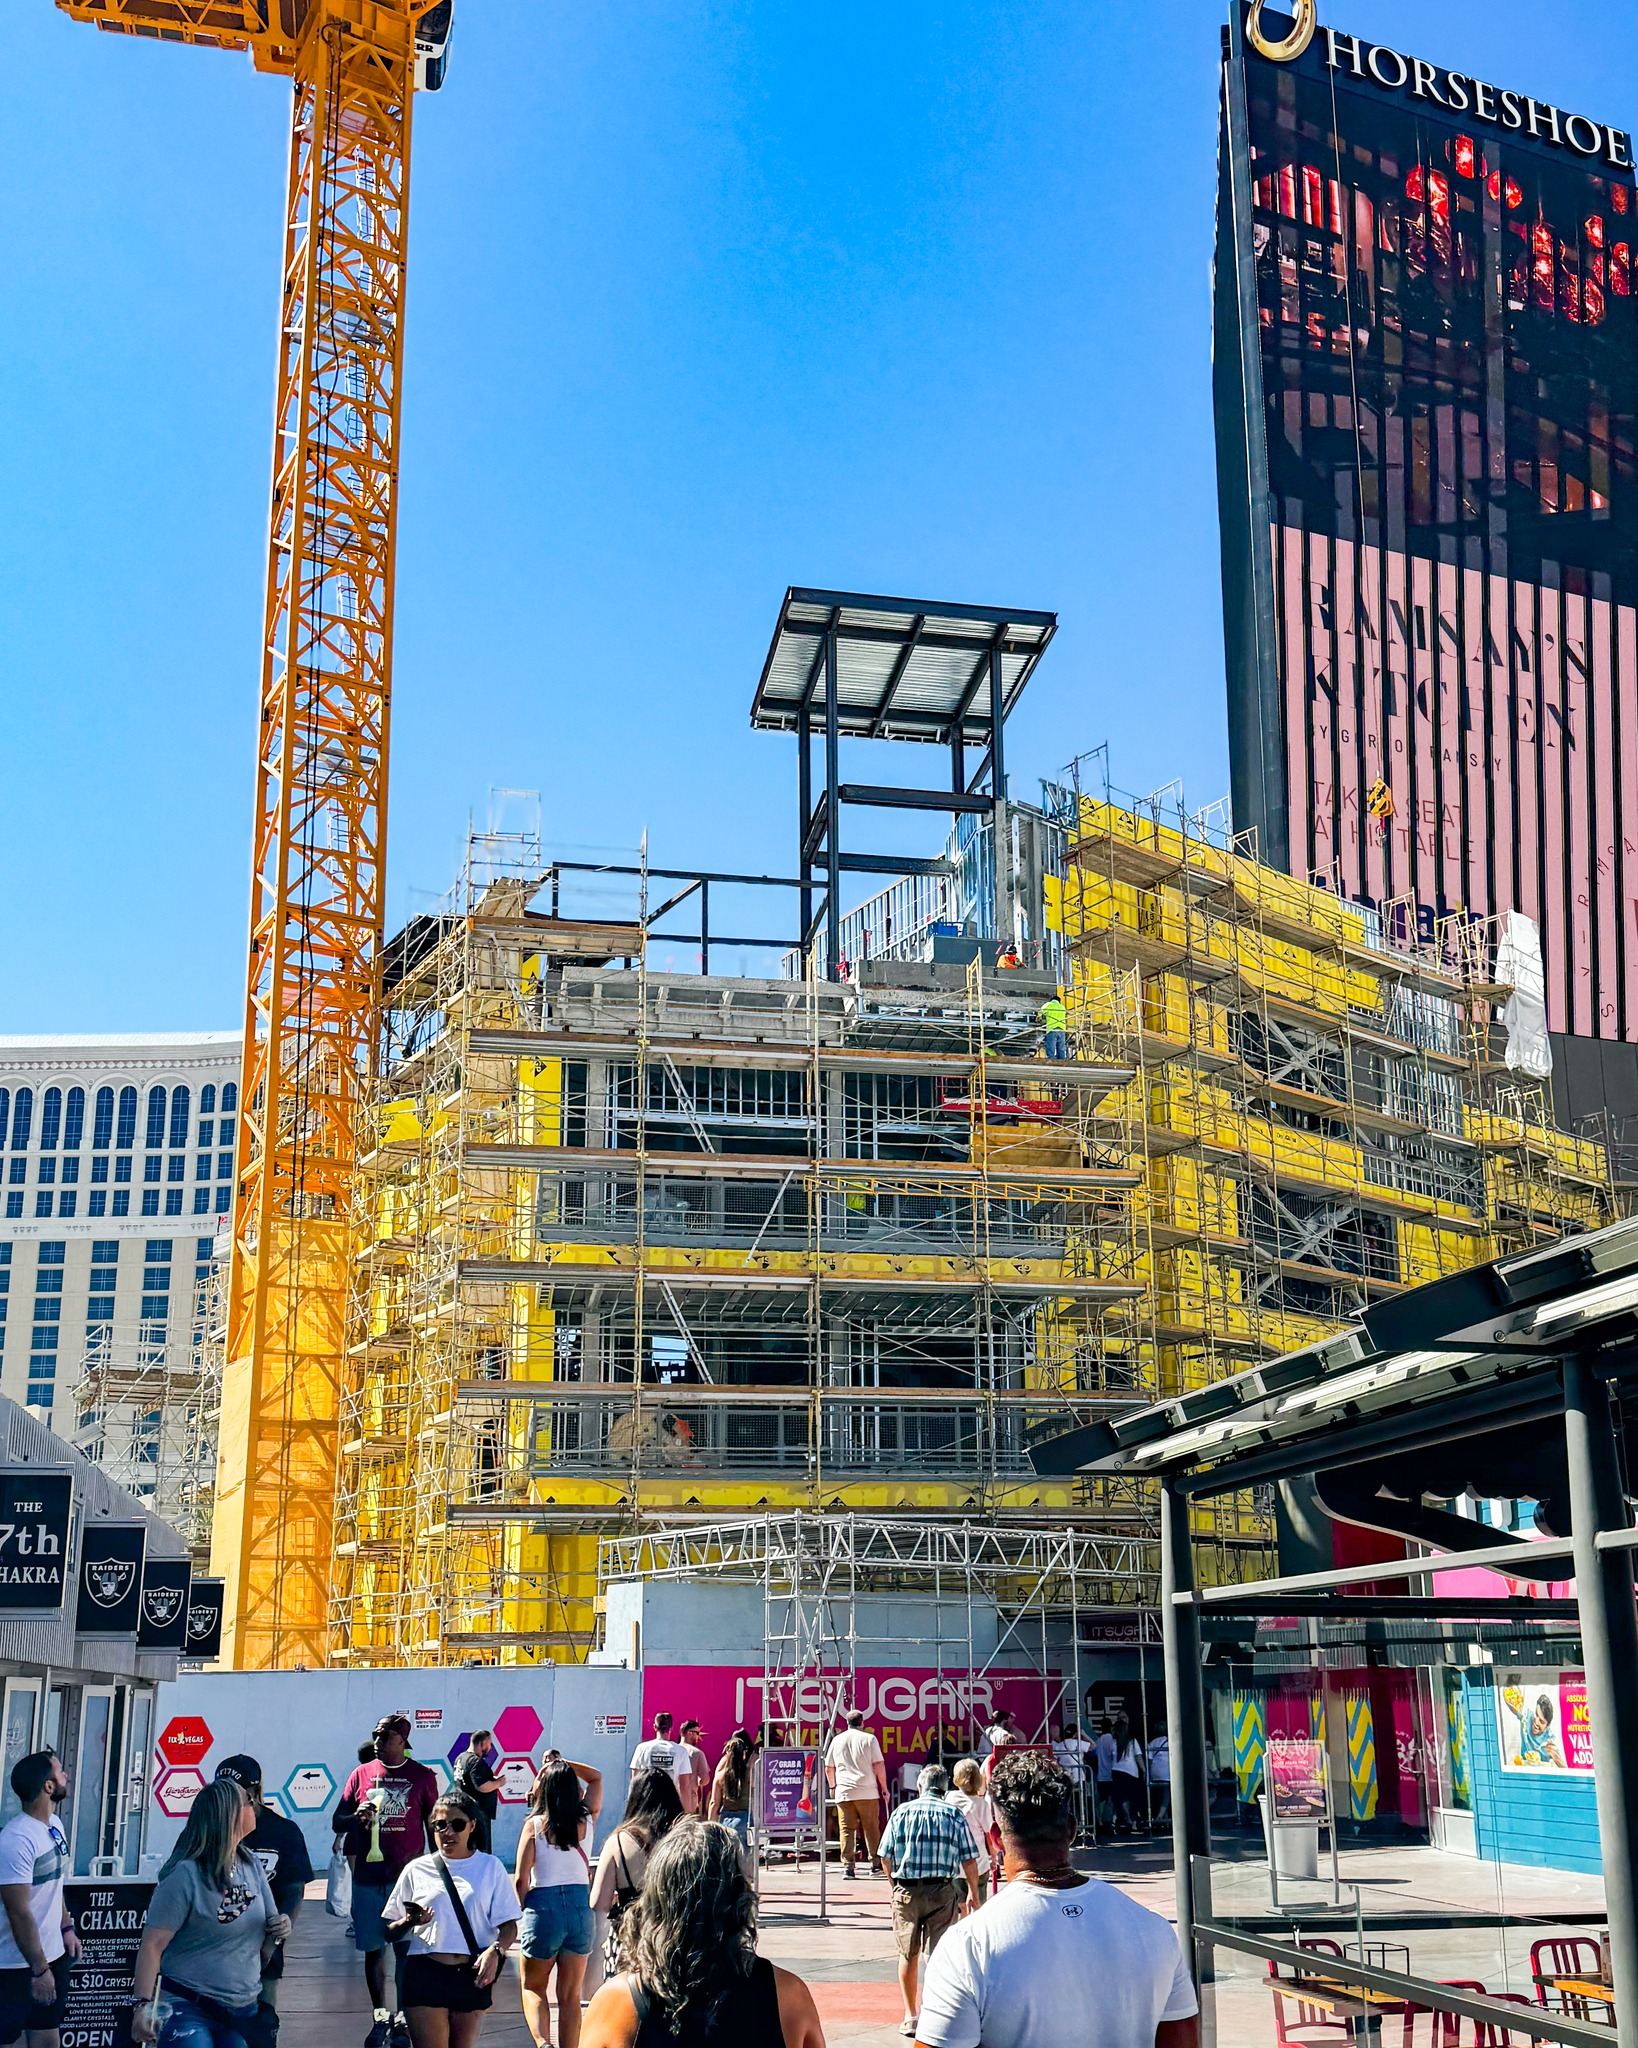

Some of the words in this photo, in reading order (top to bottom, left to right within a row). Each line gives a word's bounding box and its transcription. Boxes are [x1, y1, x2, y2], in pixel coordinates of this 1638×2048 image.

[1326, 27, 1629, 166] HORSESHOE
[1314, 780, 1374, 814] TAK
[14, 1502, 43, 1513] THE
[0, 1523, 60, 1556] 7th
[0, 1566, 60, 1584] HAKRA
[92, 1564, 130, 1572] RAIDERS
[1568, 1733, 1592, 1750] VAL
[768, 1759, 803, 1778] Frozen
[778, 1760, 796, 1768] GRAB
[796, 1760, 802, 1768] A
[772, 1777, 802, 1785] COCKTAIL
[90, 1892, 115, 1907] THE
[80, 1910, 147, 1931] CHAKRA
[81, 1973, 104, 1990] $10
[104, 1977, 135, 1988] CRYSTA
[62, 2030, 114, 2048] OPEN
